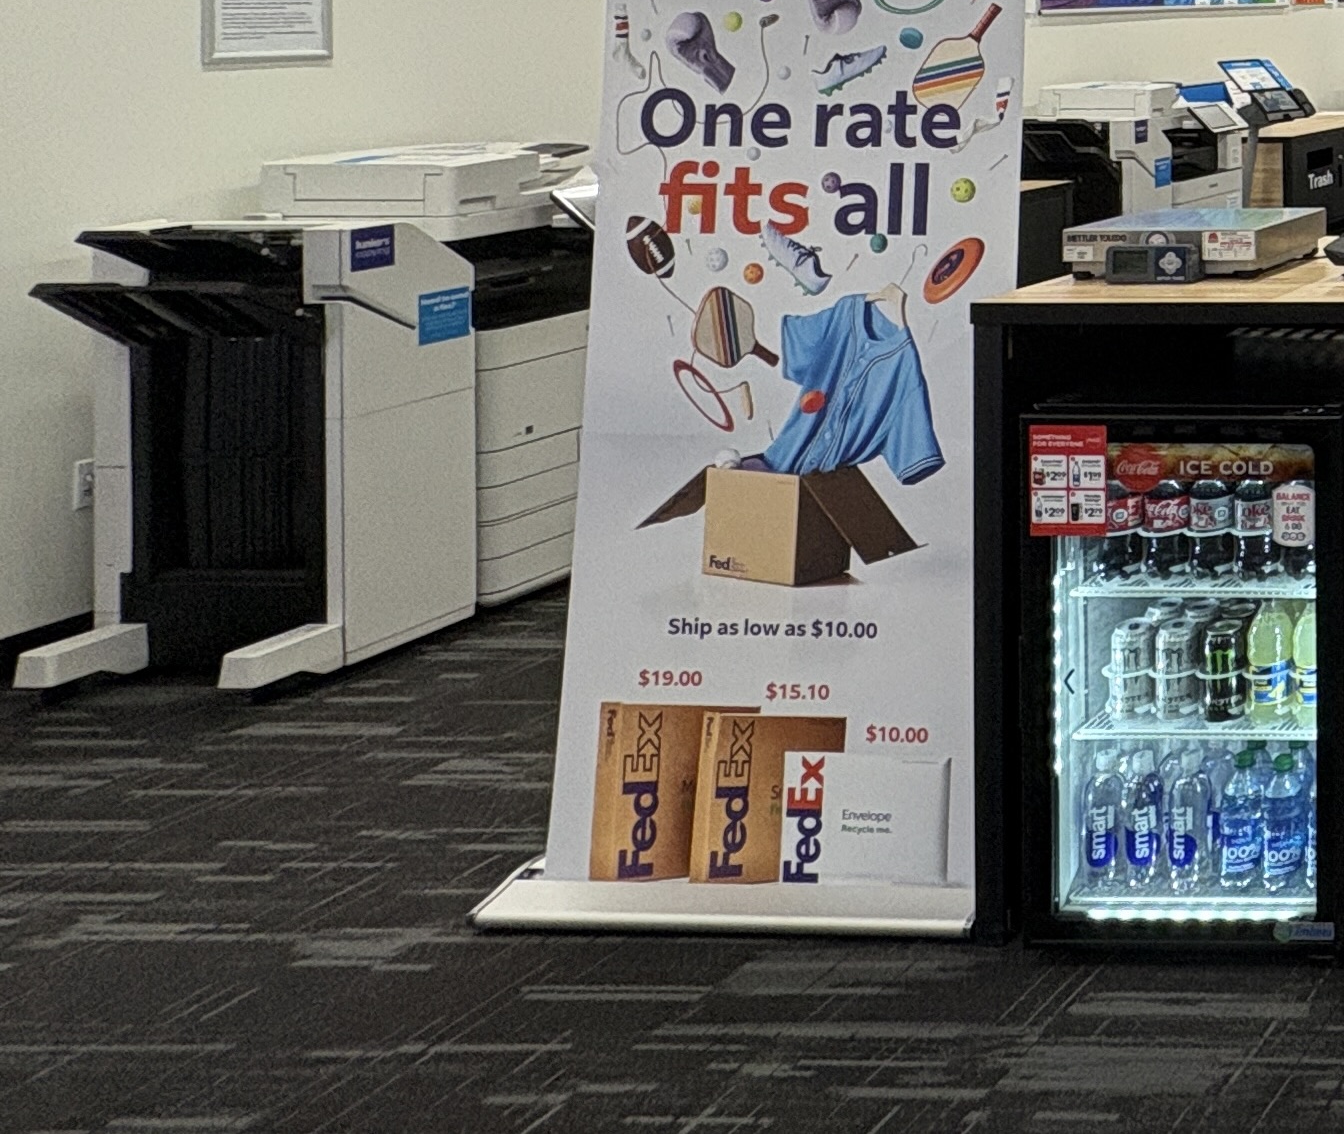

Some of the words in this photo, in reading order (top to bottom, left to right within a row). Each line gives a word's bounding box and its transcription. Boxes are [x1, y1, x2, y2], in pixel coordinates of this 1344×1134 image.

[639, 87, 791, 148] One
[813, 91, 961, 149] rate
[1307, 169, 1334, 189] Trash
[659, 160, 811, 236] fits
[833, 163, 931, 236] all
[1067, 234, 1098, 242] METTLER
[1179, 460, 1212, 475] ICE
[1219, 460, 1274, 475] COLD
[668, 618, 712, 639] Ship
[717, 623, 739, 637] as
[744, 618, 779, 636] low
[784, 622, 806, 638] as
[811, 621, 878, 639] $10.00
[638, 669, 703, 687] $19.00
[766, 683, 830, 701] $15.10
[866, 726, 929, 744] $10.00
[617, 711, 663, 879] FedEx
[709, 720, 755, 879] FedEx
[782, 755, 825, 883] FedEx
[842, 809, 892, 823] Envelope
[841, 824, 874, 835] Recycle
[1088, 805, 1106, 860] smart
[1132, 806, 1150, 859] smart
[1172, 806, 1185, 860] smart
